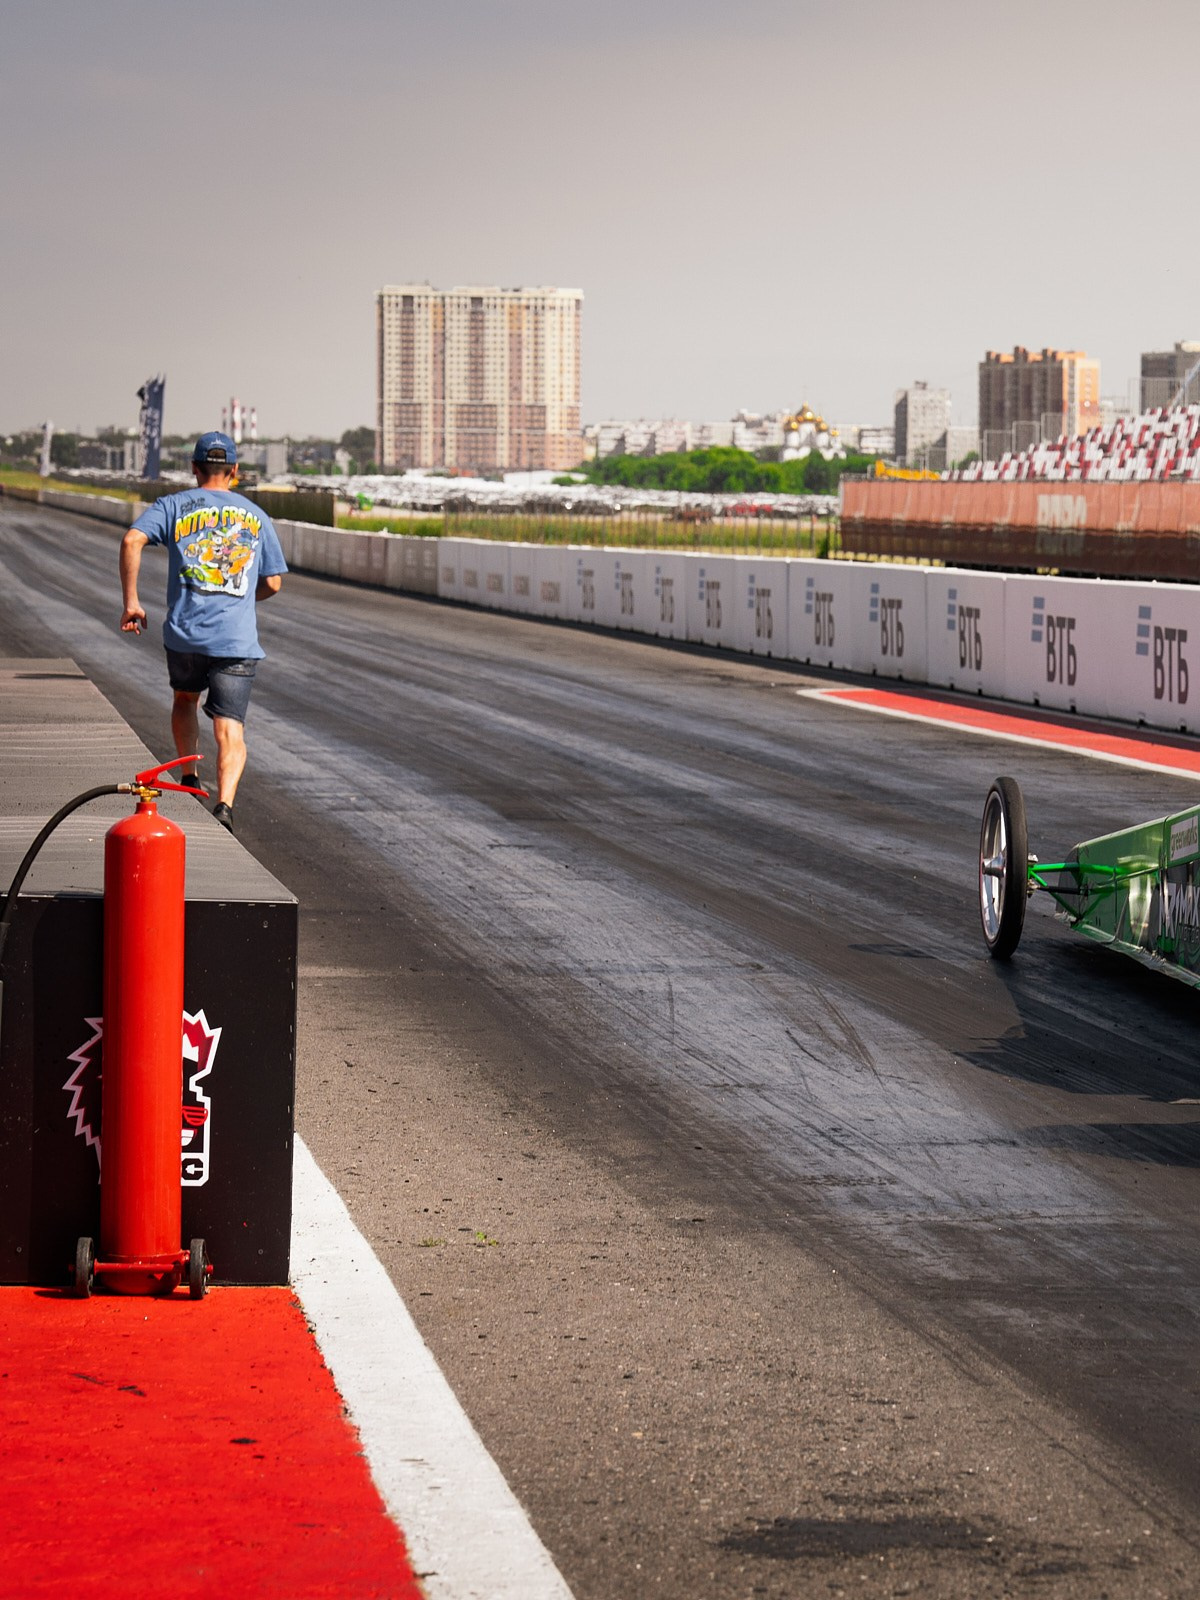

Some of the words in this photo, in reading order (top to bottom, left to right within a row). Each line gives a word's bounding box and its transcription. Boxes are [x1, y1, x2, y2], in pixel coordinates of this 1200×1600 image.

[175, 506, 219, 542] NITRO
[222, 506, 261, 539] FREAK
[880, 598, 904, 657] ВТБ
[958, 605, 982, 671] ВТБ
[1046, 615, 1077, 686] ВТБ
[1154, 626, 1189, 704] ВТБ
